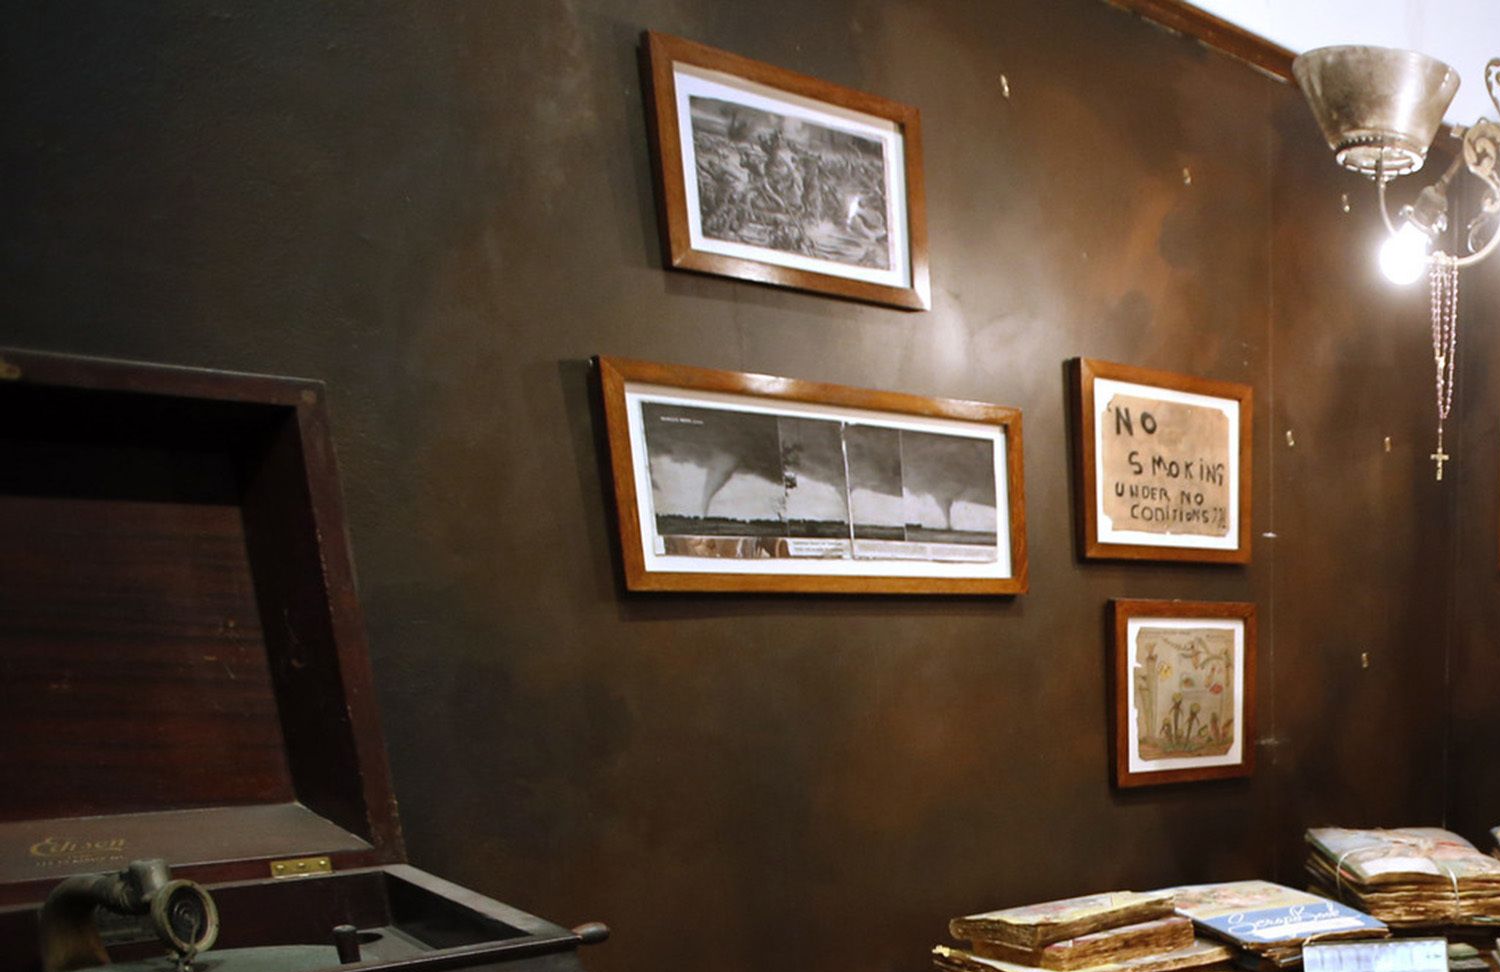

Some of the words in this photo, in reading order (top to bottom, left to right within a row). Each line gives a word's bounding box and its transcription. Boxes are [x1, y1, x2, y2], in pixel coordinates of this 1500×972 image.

[1114, 405, 1157, 436] NO
[1128, 450, 1225, 487] SMOKING
[1115, 481, 1171, 501] UNDER
[1180, 490, 1204, 506] NO
